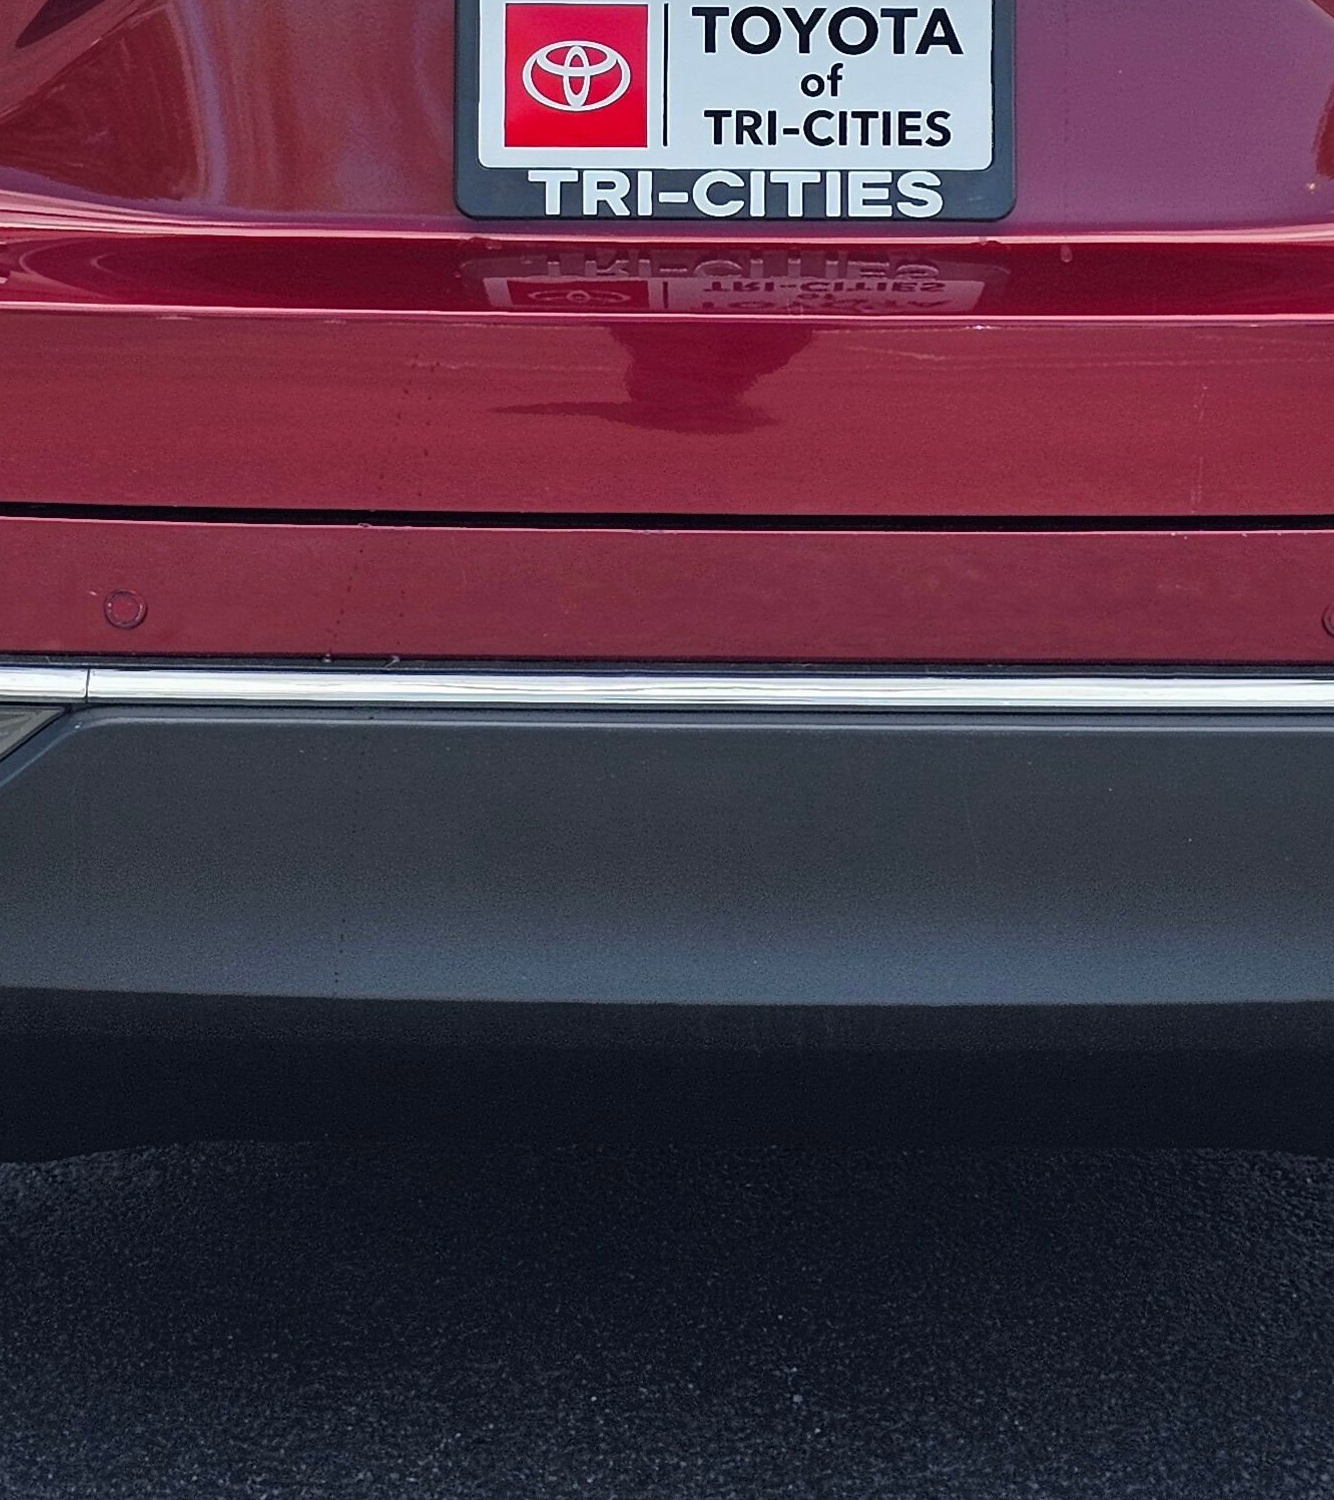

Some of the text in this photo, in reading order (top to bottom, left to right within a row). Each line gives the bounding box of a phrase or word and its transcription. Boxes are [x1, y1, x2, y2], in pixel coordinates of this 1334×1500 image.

[692, 7, 964, 55] TOYOTA
[800, 63, 844, 98] of
[704, 109, 952, 147] TRI-CITIES
[527, 170, 944, 217] TRI-CITIES
